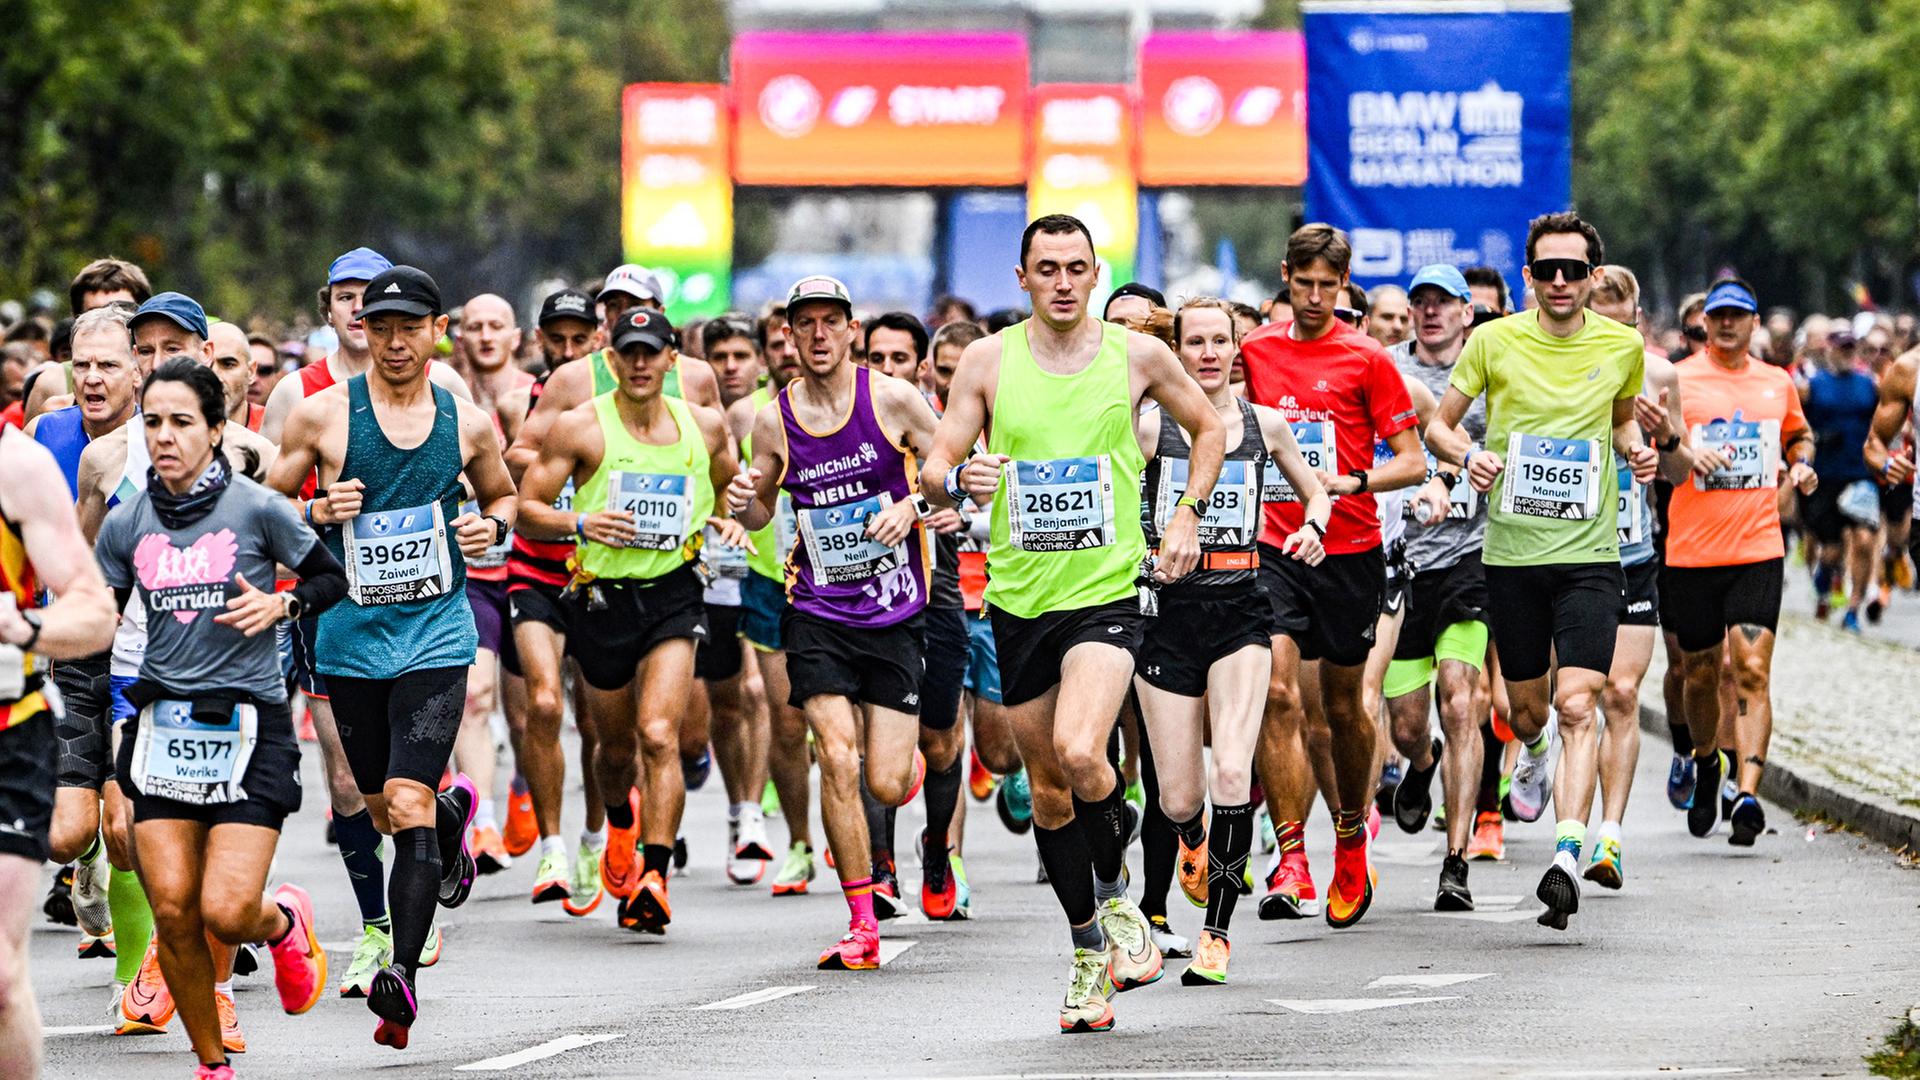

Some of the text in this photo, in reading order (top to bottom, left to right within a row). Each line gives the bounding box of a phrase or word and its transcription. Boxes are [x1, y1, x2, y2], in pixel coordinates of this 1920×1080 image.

[1350, 91, 1457, 128] BMW
[1350, 129, 1458, 155] BERLIN
[1350, 157, 1523, 187] MARATHON
[1279, 395, 1299, 409] 46.
[798, 453, 861, 482] WellChild
[1522, 463, 1583, 485] 19665
[813, 481, 868, 507] NEILL
[1532, 485, 1570, 498] Manuel
[625, 499, 677, 518] 40110
[1025, 489, 1093, 513] 28621
[1514, 497, 1562, 509] IMPOSSIBLE
[1522, 507, 1559, 518] NOTHING
[640, 520, 661, 530] Bilel
[1034, 515, 1089, 530] Benjamin
[819, 531, 872, 552] 3894
[1024, 531, 1076, 543] IMPOSSIBLE
[360, 537, 432, 566] 39627
[1024, 540, 1074, 551] IS NOTHING
[844, 550, 868, 562] Neill
[379, 565, 420, 581] Zaiwei
[826, 561, 872, 575] IMPOSSIBLE
[828, 569, 872, 583] IS NOTHING
[361, 581, 416, 595] IMPOSSIBLE
[150, 590, 225, 612] Corrida
[362, 591, 415, 605] IS NOTHING
[147, 775, 208, 794] IMPOSSIBLE
[156, 785, 205, 805] NOTHING
[1216, 808, 1246, 816] STOX
